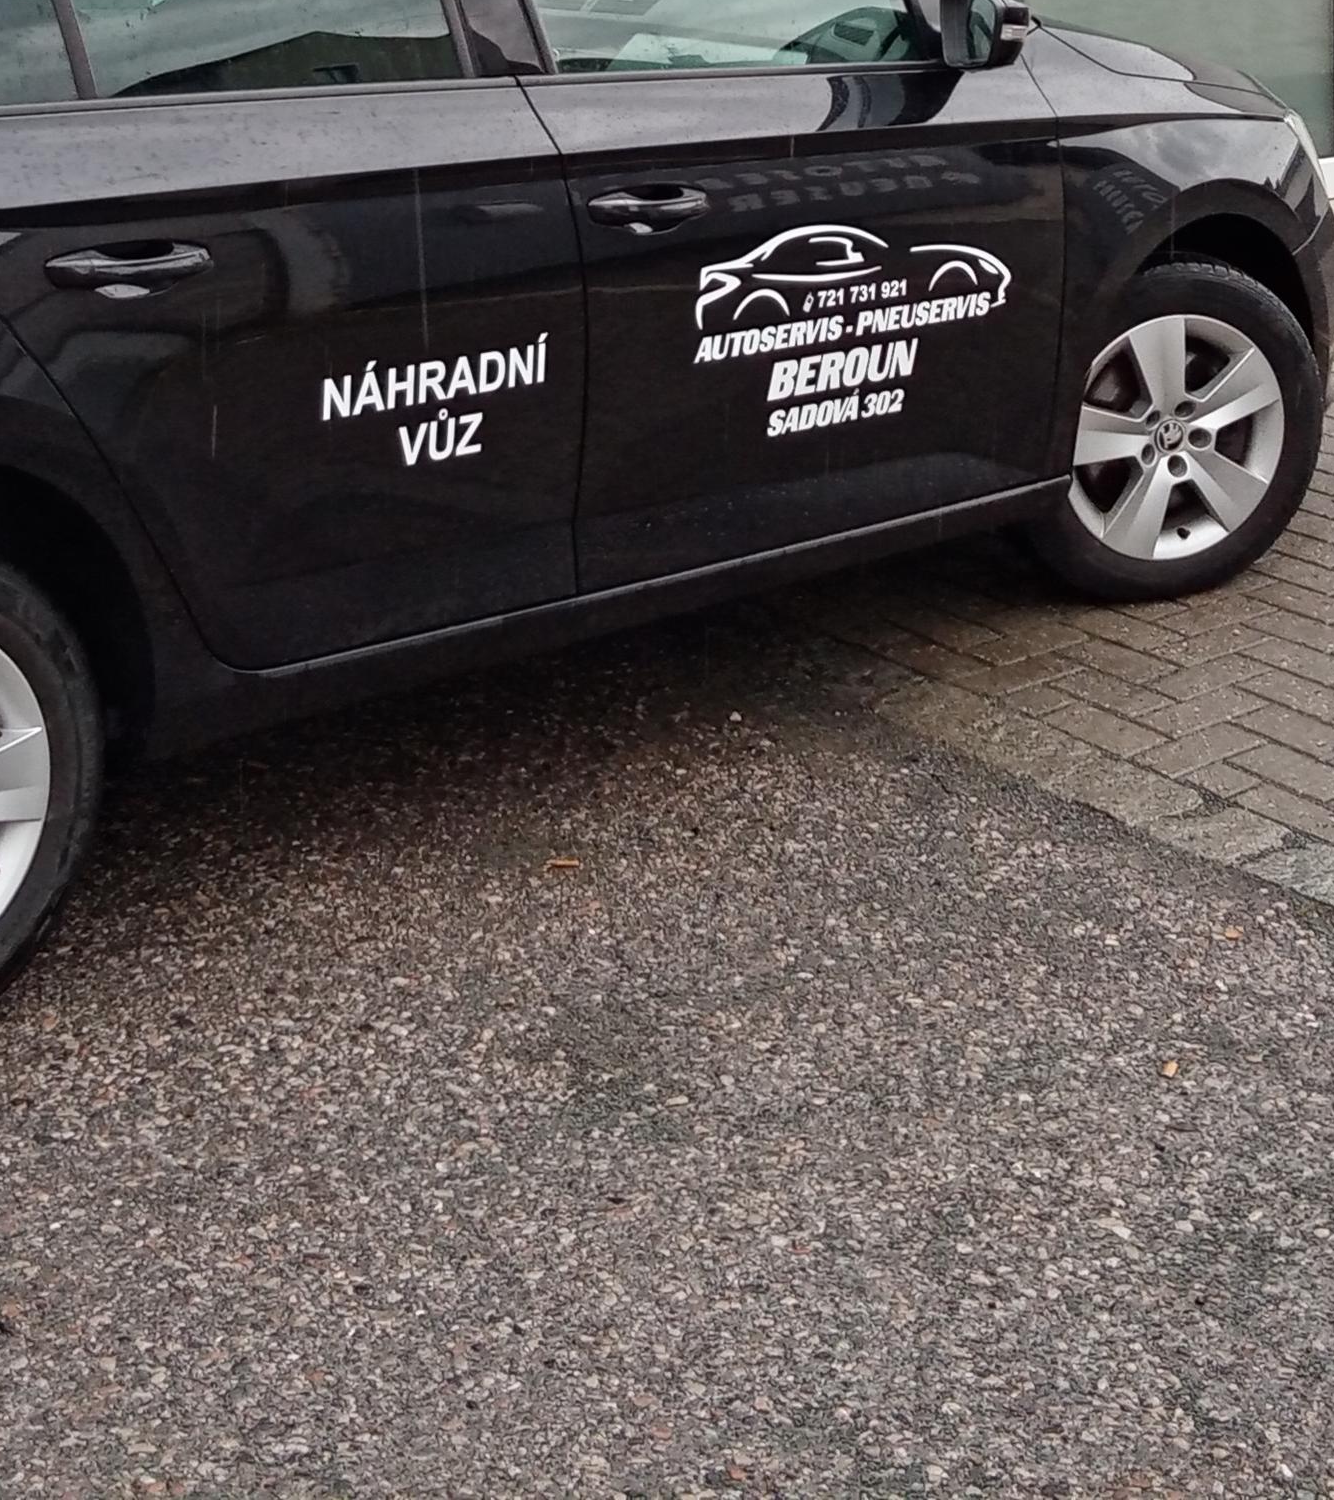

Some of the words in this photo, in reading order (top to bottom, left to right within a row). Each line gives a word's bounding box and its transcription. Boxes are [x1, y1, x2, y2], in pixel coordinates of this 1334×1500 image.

[817, 288, 844, 308] 721
[850, 284, 877, 303] 731
[881, 279, 908, 299] 921
[694, 313, 845, 363] AUTOSERVIS
[856, 291, 992, 338] PNEUSERVIS
[322, 332, 549, 421] NÁHRADNÍ
[767, 339, 919, 401] BEROUN
[398, 408, 484, 467] VŮZ
[766, 387, 860, 438] SADOVÁ
[860, 388, 905, 421] 302
